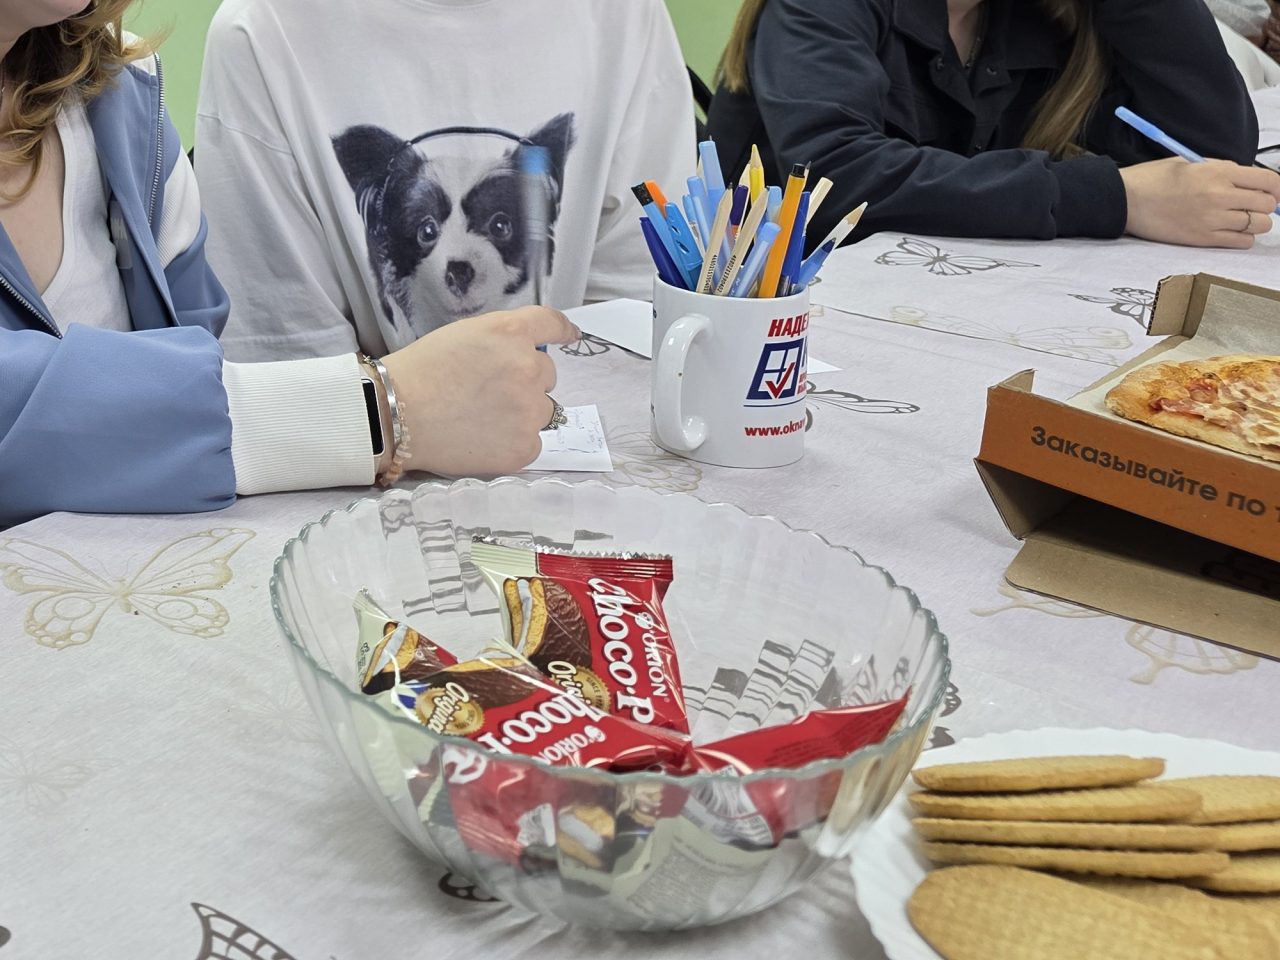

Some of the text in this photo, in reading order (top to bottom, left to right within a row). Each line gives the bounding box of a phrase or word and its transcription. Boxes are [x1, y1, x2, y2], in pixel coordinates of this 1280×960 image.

[1030, 426, 1266, 517] Заказывайте по
[427, 682, 470, 736] Origina
